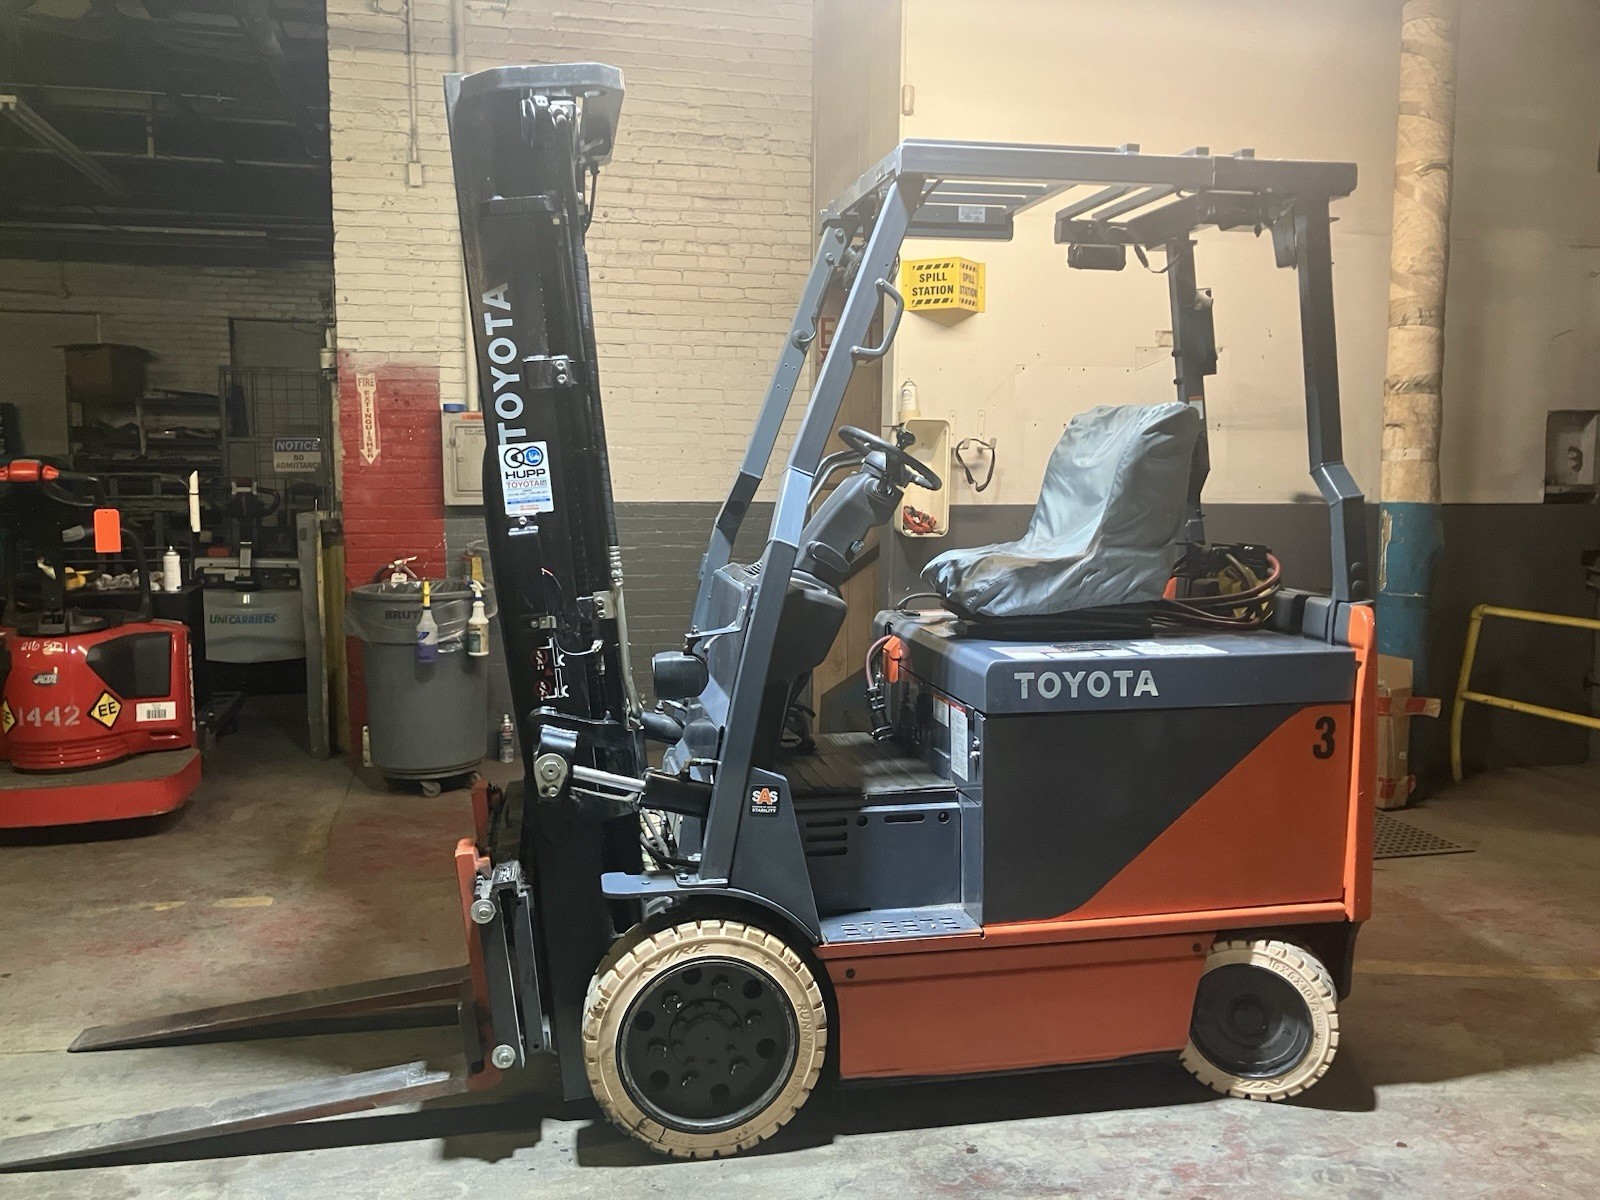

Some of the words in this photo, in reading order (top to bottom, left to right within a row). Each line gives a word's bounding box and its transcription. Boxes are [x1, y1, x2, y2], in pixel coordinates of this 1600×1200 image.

[919, 272, 948, 283] SPILL
[962, 272, 975, 285] SPILL
[912, 285, 954, 297] STATION
[960, 284, 978, 298] STATION
[482, 282, 527, 446] TOYOTA
[358, 378, 375, 388] FIRE
[276, 440, 321, 451] NOTICE
[505, 468, 546, 480] HUPP
[507, 480, 540, 489] TOYOTA
[1014, 670, 1159, 700] TOYOTA
[18, 706, 81, 727] 1442
[98, 702, 118, 718] EE
[1312, 716, 1336, 760] 3
[752, 788, 778, 805] SAS
